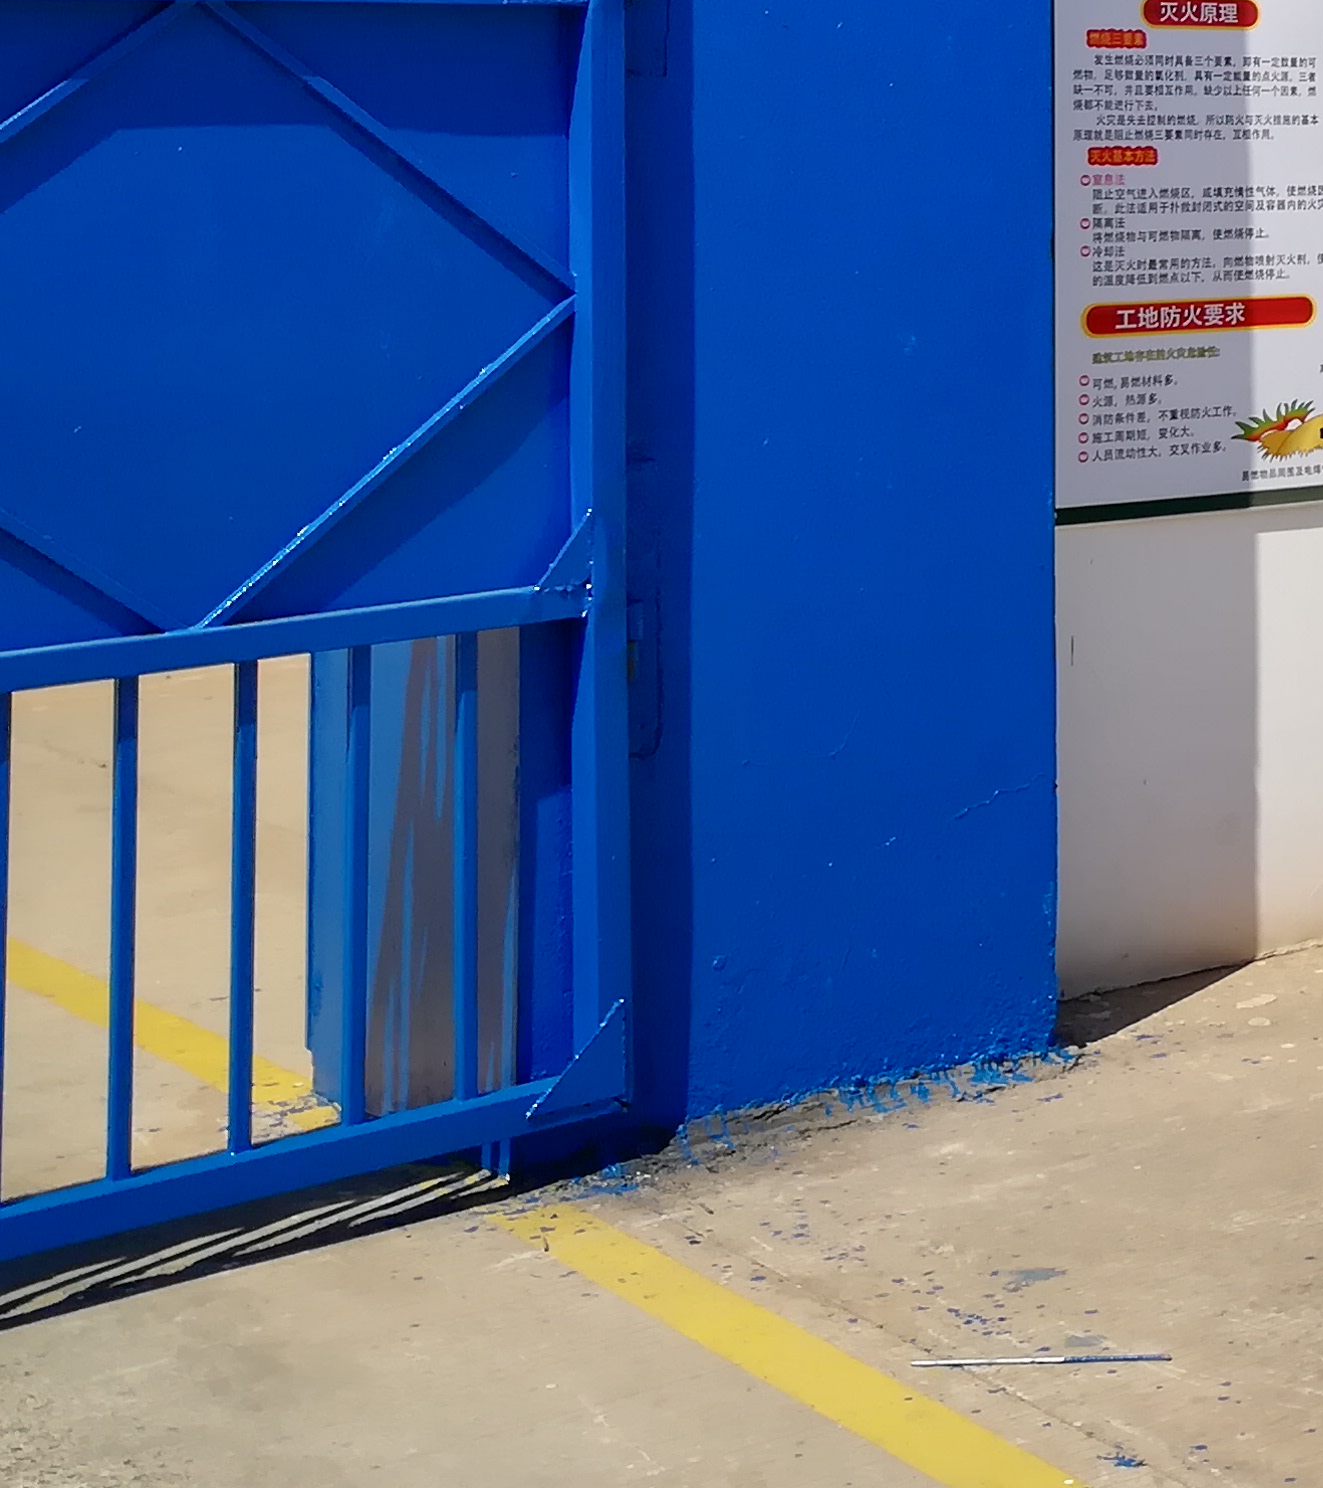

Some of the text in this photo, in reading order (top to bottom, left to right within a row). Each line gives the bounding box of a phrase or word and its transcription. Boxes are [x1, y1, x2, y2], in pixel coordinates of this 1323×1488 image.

[1160, 2, 1238, 24] 灭火原理
[1089, 32, 1144, 47] 燃烧三要素
[1090, 150, 1155, 162] 灭火基本方法
[1092, 217, 1126, 229] 隔离法
[1092, 246, 1126, 258] 冷却法
[1115, 302, 1245, 329] 工地防火要求
